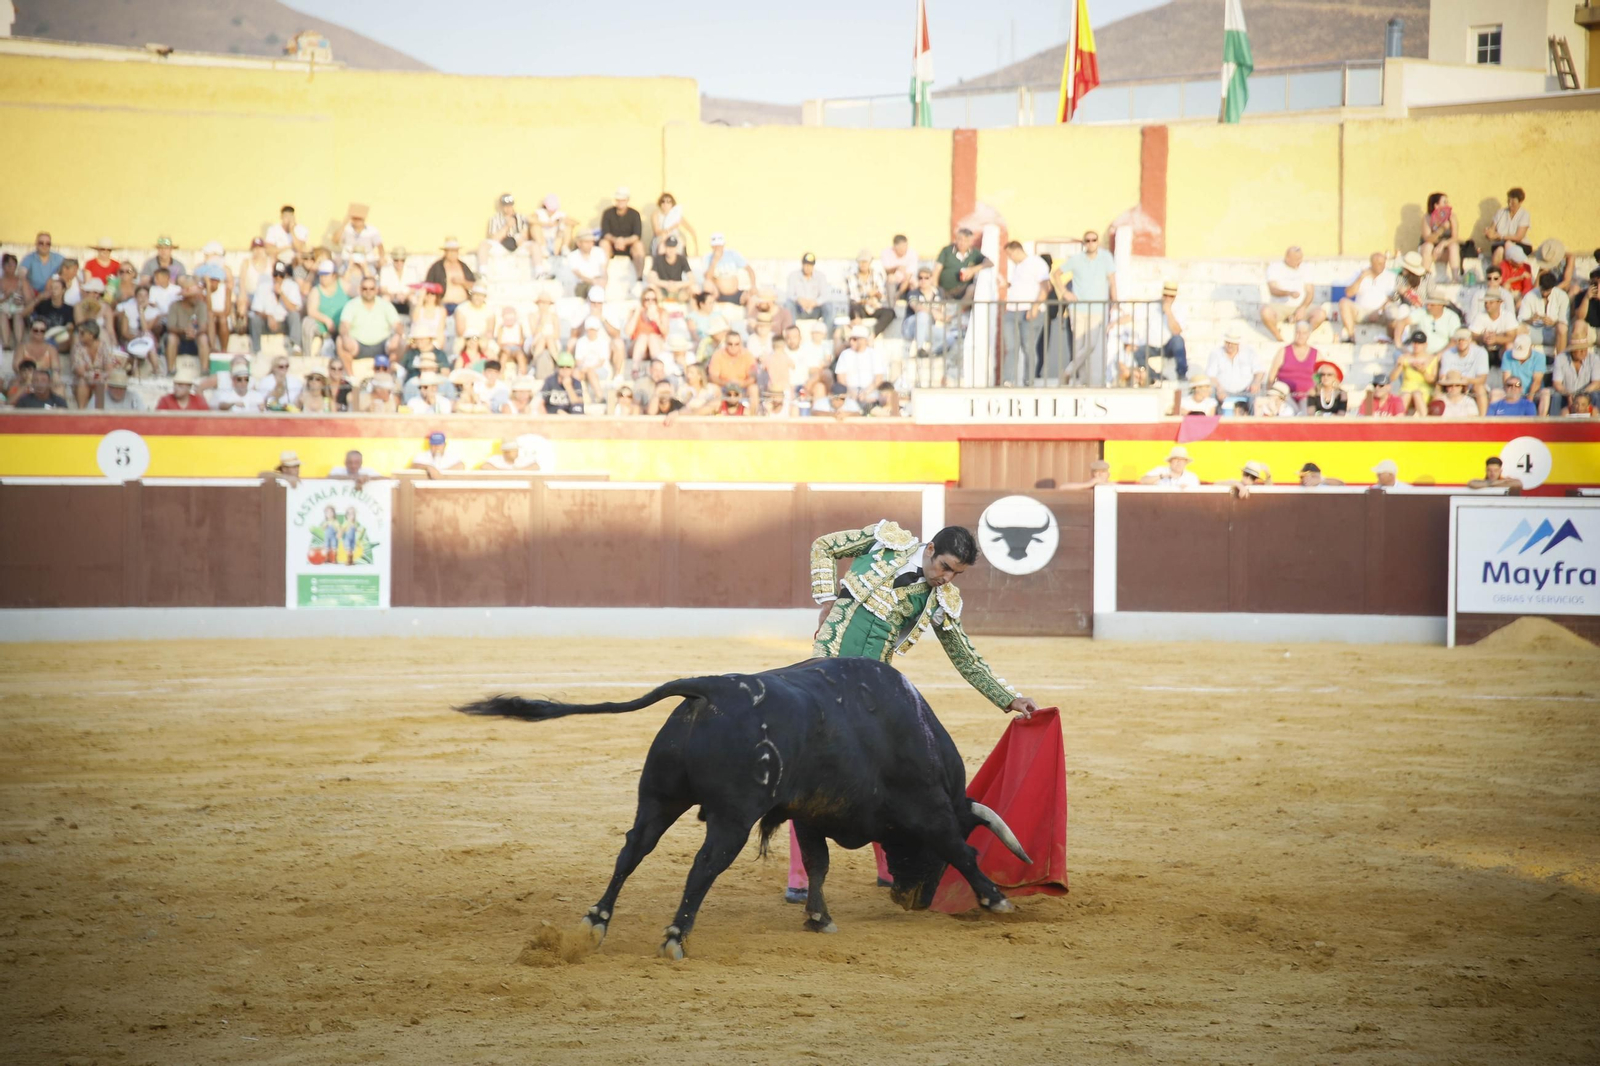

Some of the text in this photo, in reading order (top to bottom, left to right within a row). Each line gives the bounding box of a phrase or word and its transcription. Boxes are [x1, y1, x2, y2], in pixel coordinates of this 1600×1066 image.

[965, 398, 1109, 418] TORILES
[115, 446, 131, 467] 5
[1516, 453, 1534, 473] 4
[293, 485, 384, 527] CASTALA FRUITS
[1481, 561, 1597, 591] Mayfra
[1493, 594, 1585, 605] OBRAS Y SERVICIOS
